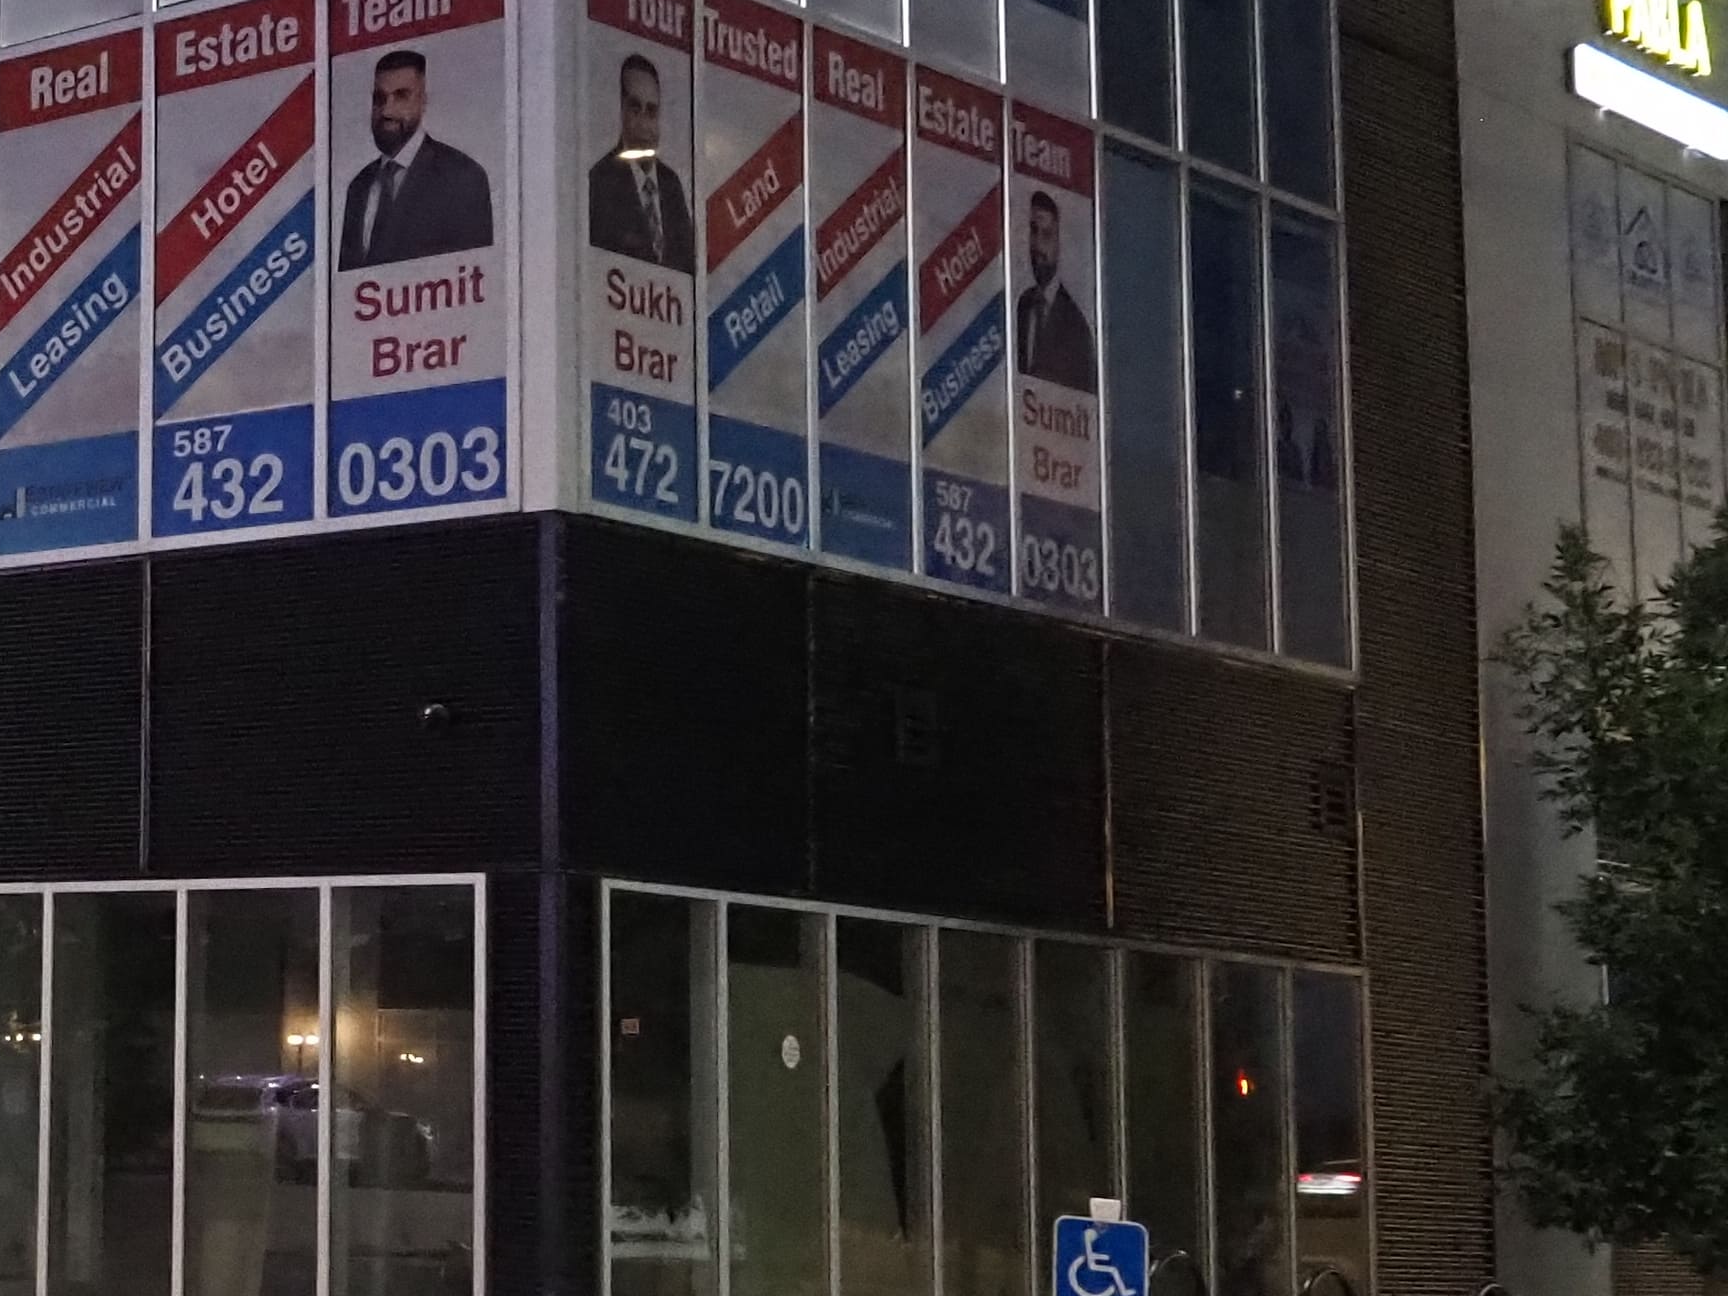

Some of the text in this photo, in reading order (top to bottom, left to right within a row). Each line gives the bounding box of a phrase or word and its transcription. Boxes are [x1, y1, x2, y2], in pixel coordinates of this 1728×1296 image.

[30, 51, 110, 111] Real
[175, 12, 299, 77] Estate
[703, 12, 798, 80] Trusted
[828, 51, 885, 111] Real
[918, 87, 997, 152] Estate
[1011, 121, 1073, 178] Team
[189, 143, 279, 240] Hotel
[727, 166, 781, 227] Land
[817, 175, 903, 283] Industrial
[934, 227, 983, 295] Hotel
[160, 229, 310, 383] Business
[353, 266, 486, 322] Sumit
[606, 269, 683, 326] Sukh
[723, 279, 786, 349] Retail
[7, 272, 130, 401] Leasing
[370, 331, 467, 378] Brar
[613, 329, 678, 384] Brar
[822, 298, 899, 390] Leasing
[922, 325, 1002, 423] Business
[173, 425, 232, 456] 587
[606, 398, 652, 435] 403
[1022, 388, 1091, 441] Sumit
[172, 426, 502, 523] 432 0303
[603, 434, 806, 534] 472 7200
[934, 480, 974, 515] 587
[1032, 445, 1084, 489] Brar
[933, 510, 1101, 601] 432 0303
